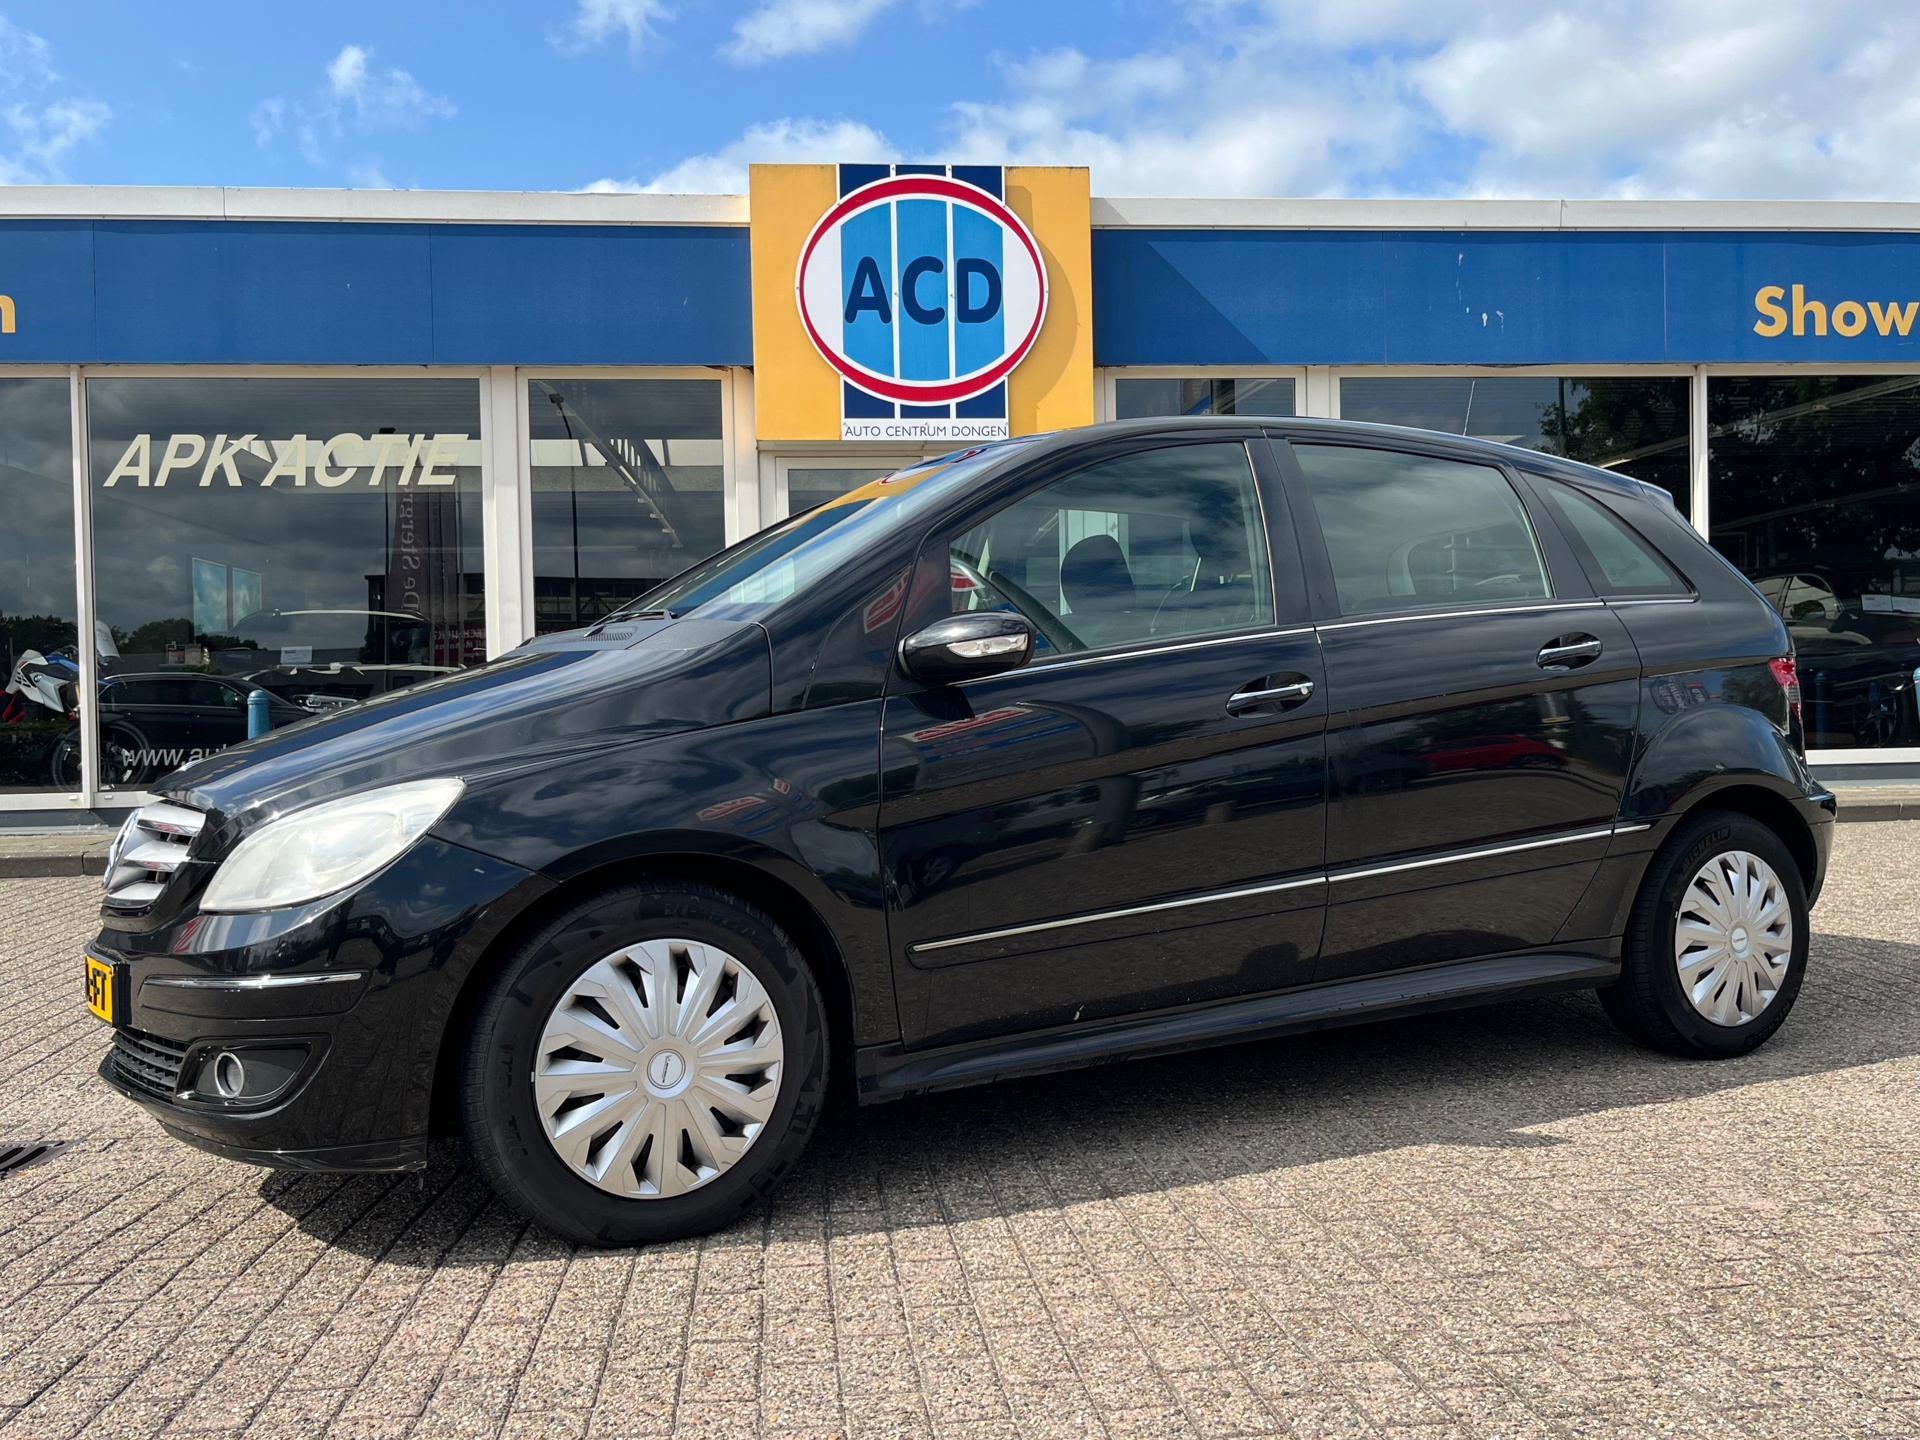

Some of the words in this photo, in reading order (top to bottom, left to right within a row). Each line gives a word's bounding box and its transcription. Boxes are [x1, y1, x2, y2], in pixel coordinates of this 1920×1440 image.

[844, 255, 1002, 326] ACD
[1753, 284, 1919, 337] Show
[845, 426, 881, 437] AUTO
[885, 426, 946, 437] CENTRUM
[951, 425, 1007, 437] DONGEN
[102, 433, 258, 487] APK
[260, 433, 469, 487] ACTIE
[121, 743, 227, 767] www.a
[1681, 828, 1729, 873] MICHELIN
